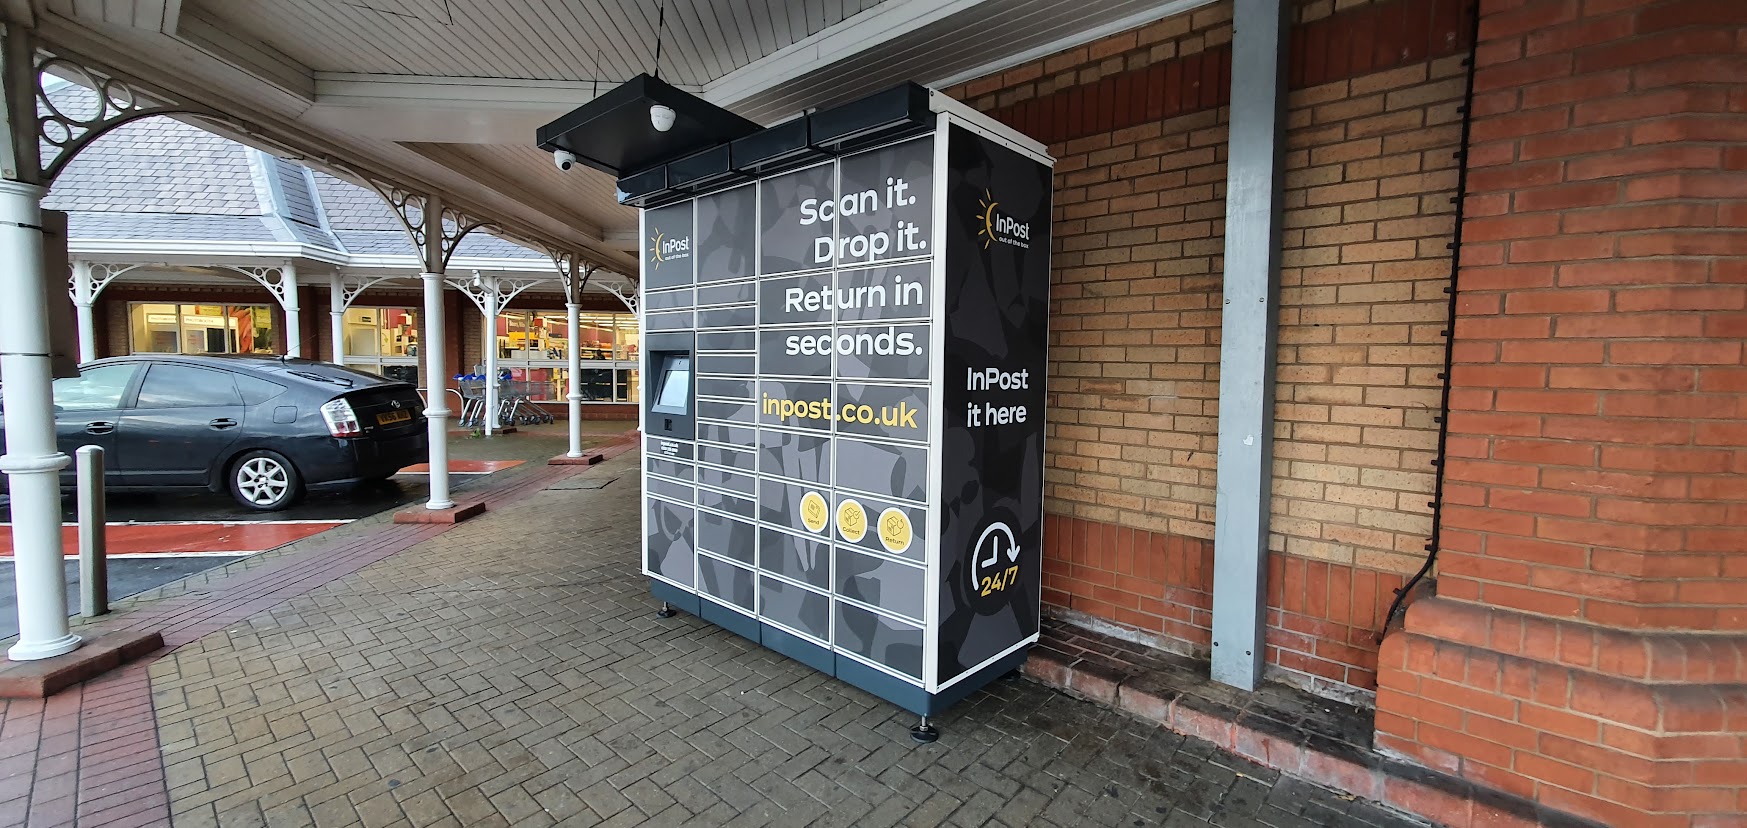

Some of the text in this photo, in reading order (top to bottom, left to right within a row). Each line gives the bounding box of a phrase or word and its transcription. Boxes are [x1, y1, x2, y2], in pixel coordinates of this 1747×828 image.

[800, 177, 917, 226] Scan it.
[996, 213, 1030, 241] InPost
[662, 236, 689, 254] InPost
[814, 221, 927, 265] Drop it.
[785, 275, 923, 313] Return in
[785, 326, 923, 357] seconds.
[966, 366, 1029, 391] InPost
[762, 392, 918, 429] inpost.co.uk
[967, 401, 1027, 428] it here
[807, 517, 820, 526] Send
[842, 526, 861, 536] Collect
[885, 536, 905, 546] Return
[981, 565, 1019, 597] 24/7
